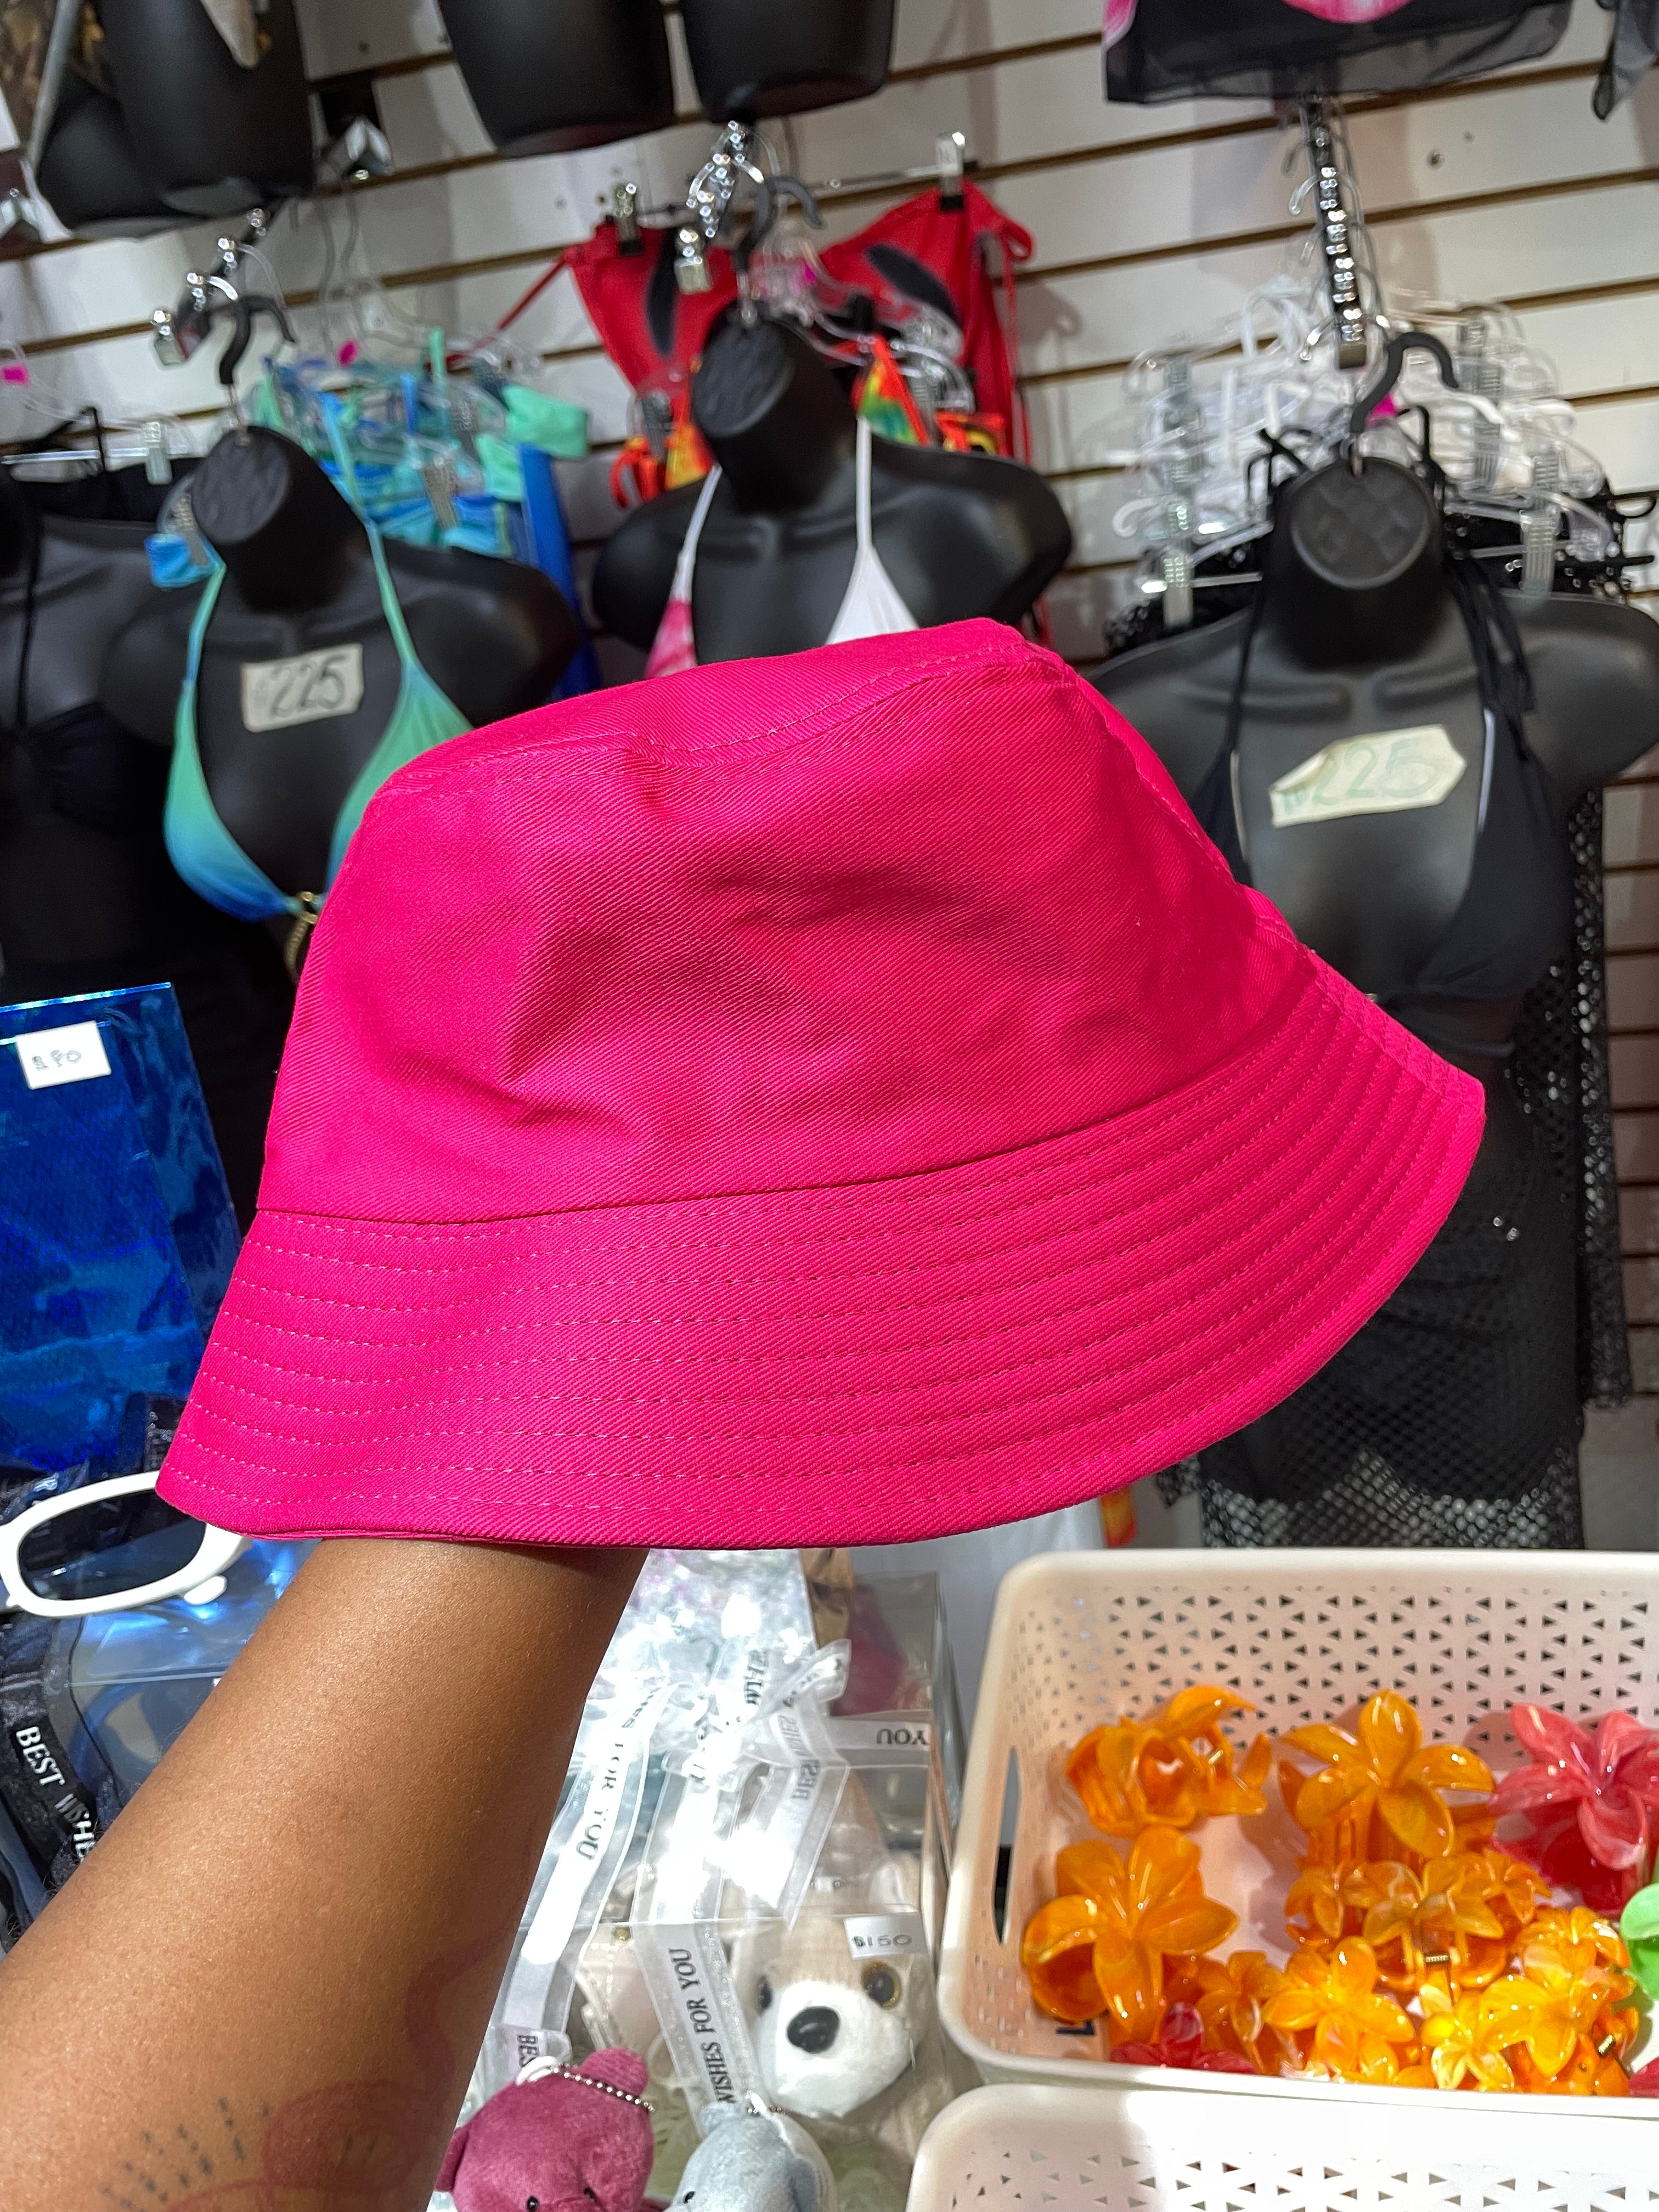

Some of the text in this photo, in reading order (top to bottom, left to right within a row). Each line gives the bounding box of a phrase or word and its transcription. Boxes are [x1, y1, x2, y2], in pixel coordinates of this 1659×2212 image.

[16, 1726, 65, 1786] BEST
[876, 1729, 929, 1746] YOU
[669, 1948, 701, 1991] YOU
[686, 1997, 716, 2034] FOR
[517, 2034, 539, 2068] BES
